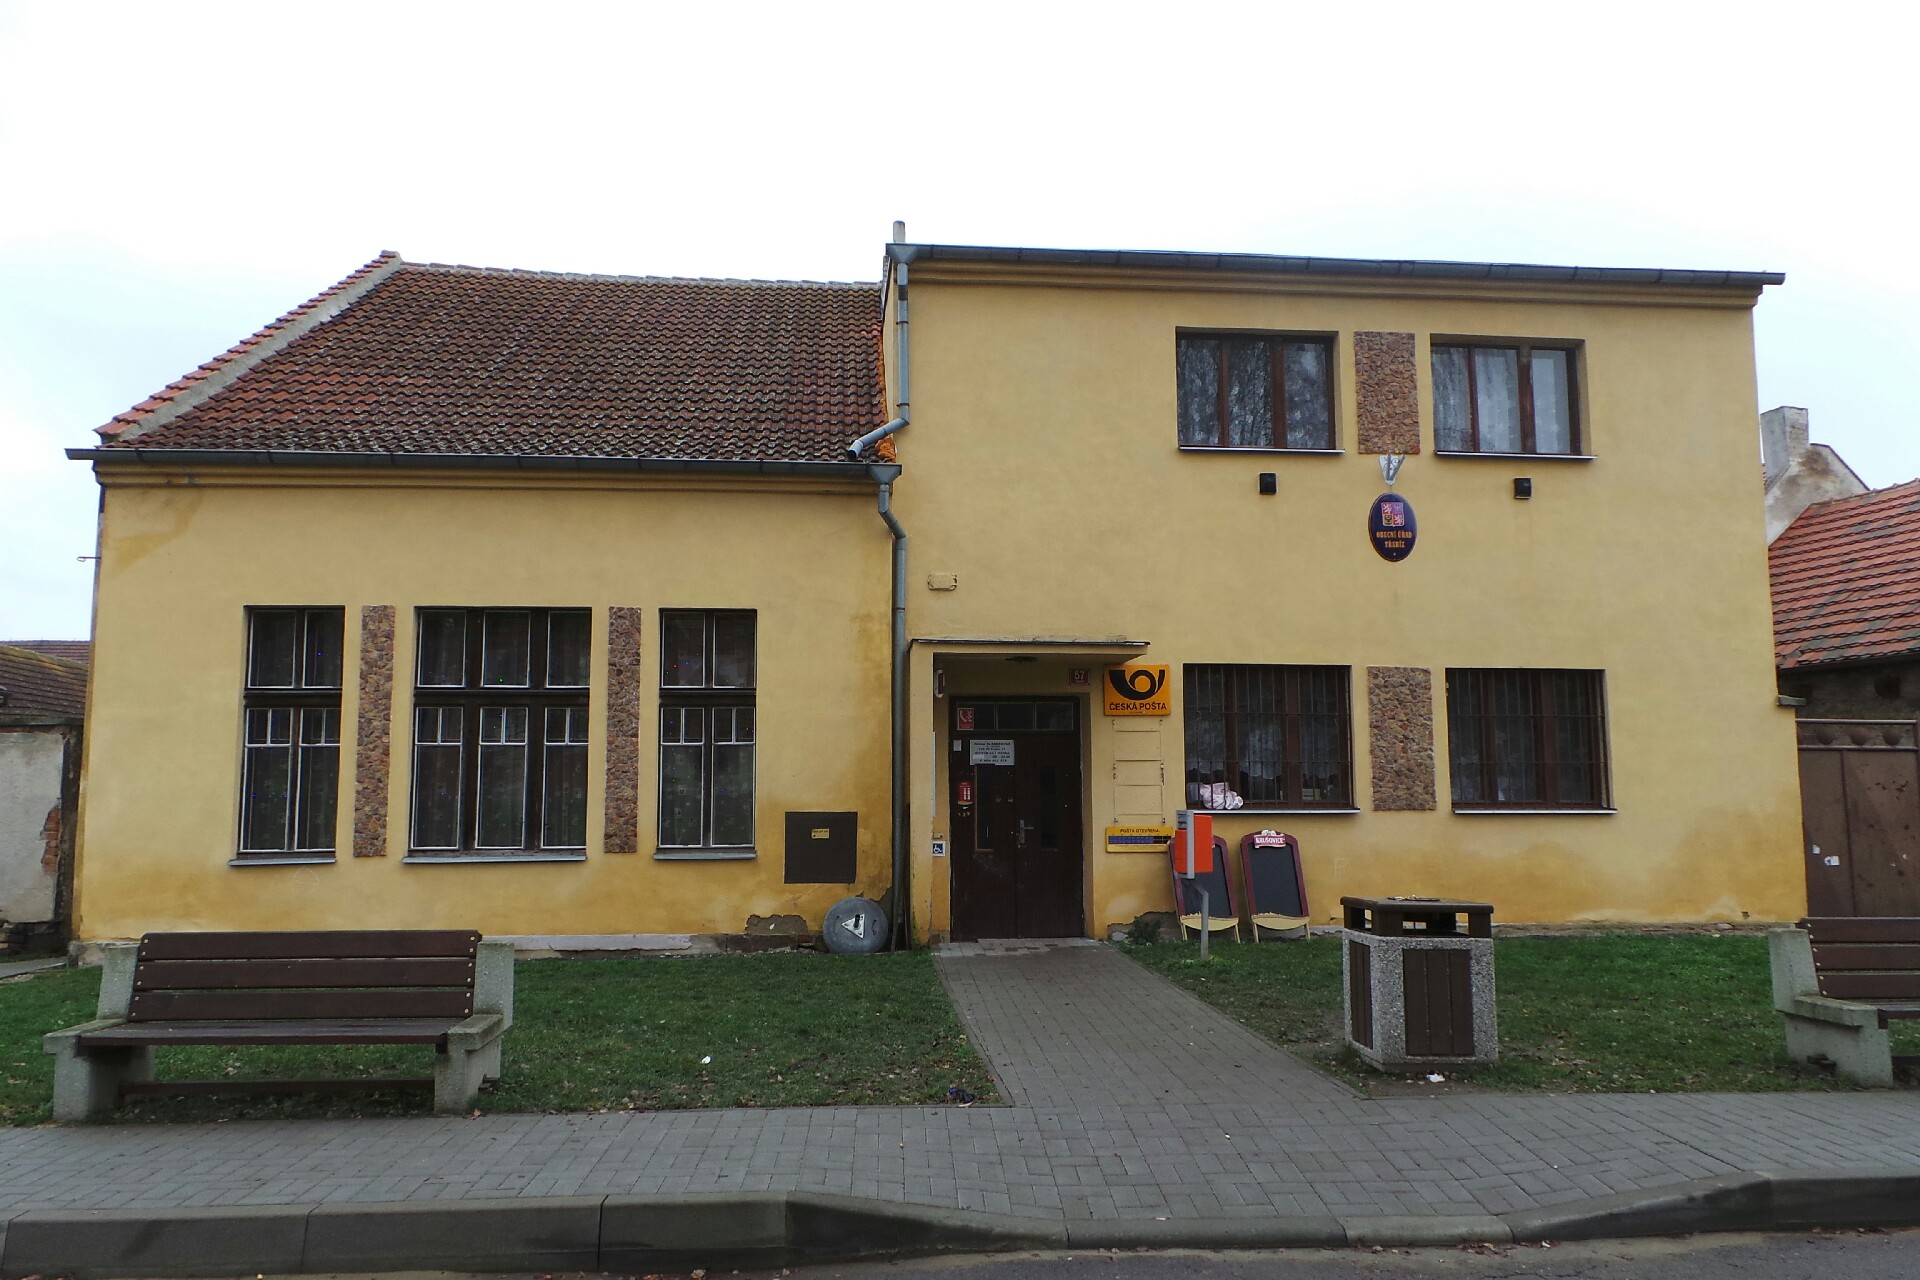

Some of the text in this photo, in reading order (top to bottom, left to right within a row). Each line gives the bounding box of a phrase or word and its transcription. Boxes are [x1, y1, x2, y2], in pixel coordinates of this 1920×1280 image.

[1074, 670, 1085, 680] 57
[1109, 702, 1167, 710] ČESKÁ POŠTA
